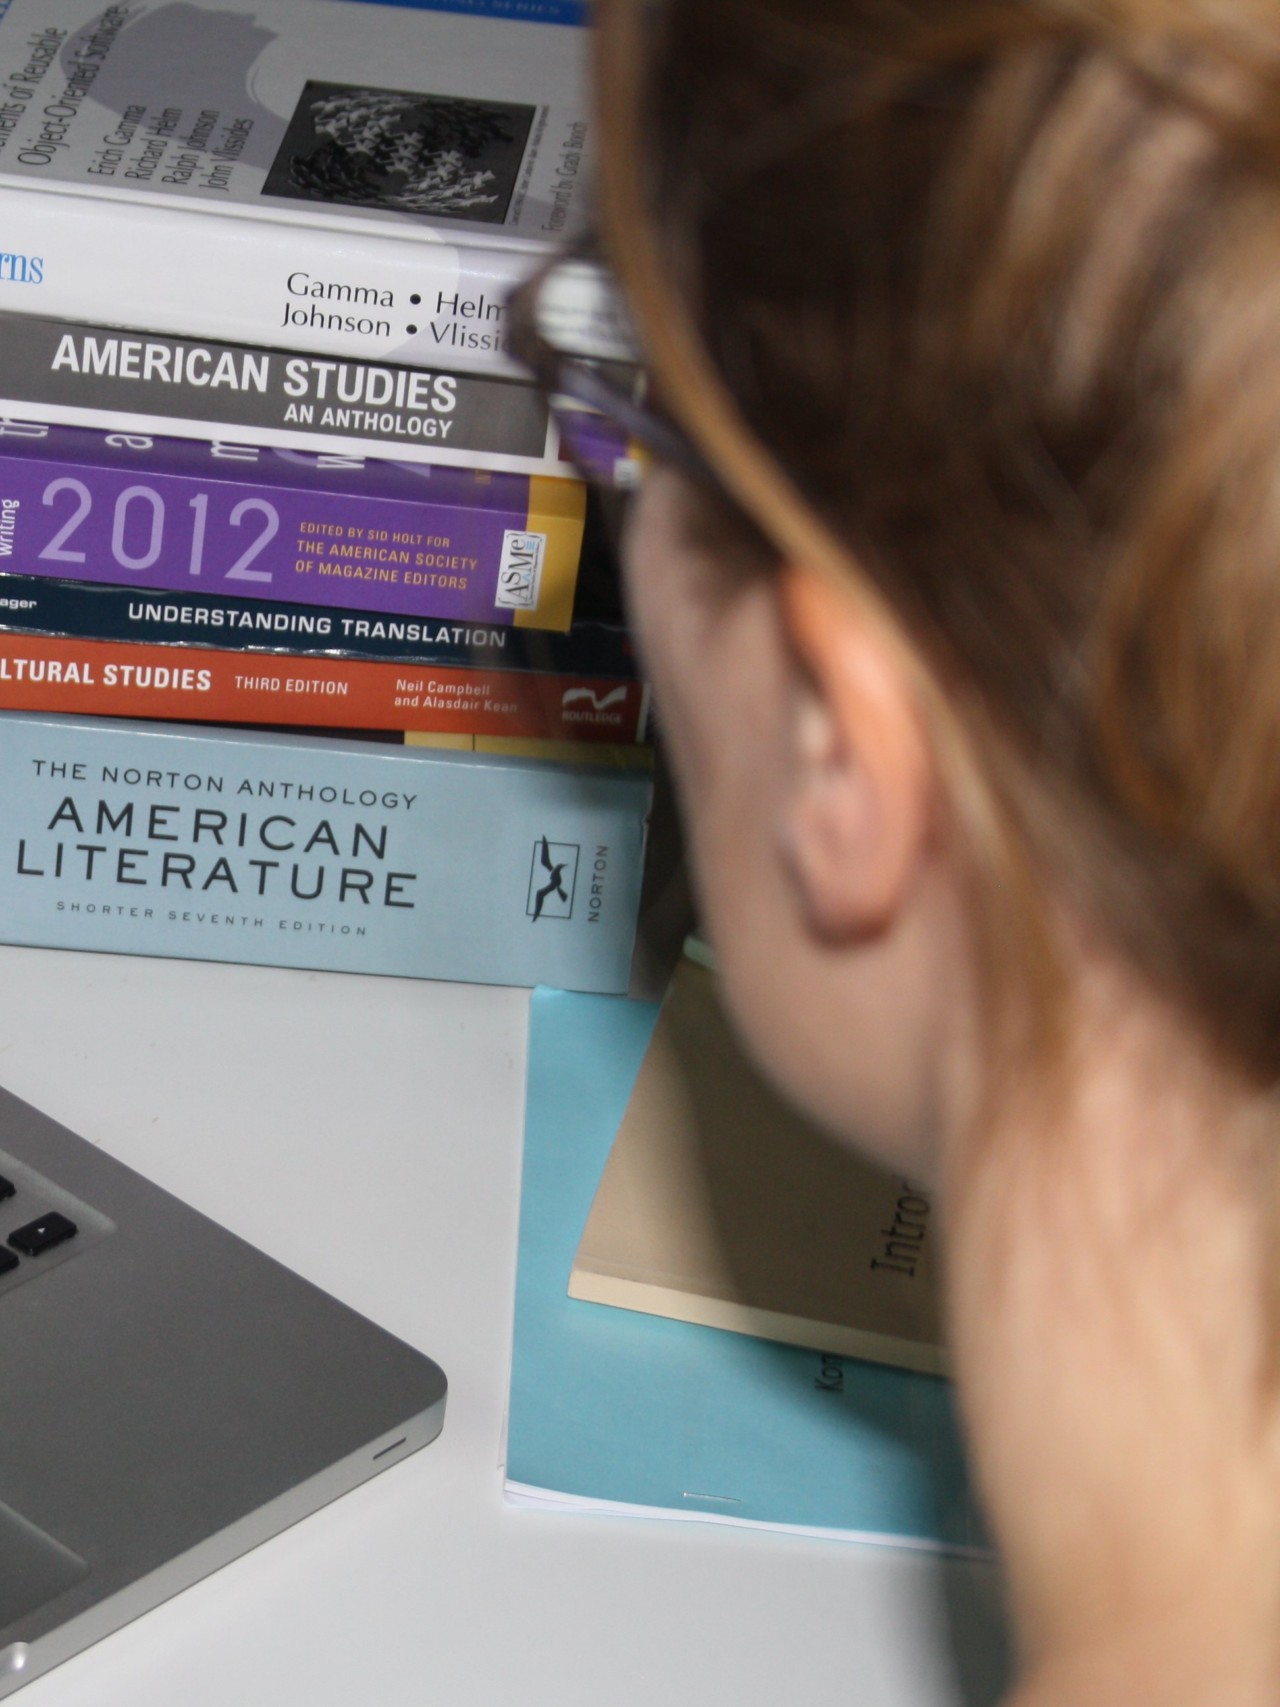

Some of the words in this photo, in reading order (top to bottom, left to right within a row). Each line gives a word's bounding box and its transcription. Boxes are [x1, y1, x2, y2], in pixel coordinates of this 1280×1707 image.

[3, 73, 35, 100] of
[20, 27, 68, 84] Reusable
[17, 60, 101, 166] Object-Oriented
[81, 4, 129, 60] Software
[104, 104, 147, 147] Gamma
[124, 137, 168, 181] Richard
[146, 107, 183, 138] Helm
[177, 109, 220, 154] Johnson
[210, 117, 254, 162] Vlissides
[88, 144, 123, 177] Erich
[161, 153, 205, 186] Ralph
[198, 165, 234, 192] John
[286, 272, 395, 308] Gamma
[436, 291, 508, 322] Helm
[280, 302, 391, 337] Johnson
[430, 321, 506, 352] Vlissi
[51, 334, 269, 393] AMERICAN
[283, 358, 458, 413] STUDIES
[283, 403, 314, 424] AN
[320, 407, 453, 439] ANTHOLOGY
[38, 477, 280, 583] 2012
[300, 521, 343, 537] EDITED
[348, 525, 363, 538] BY
[367, 527, 388, 542] SID
[392, 531, 422, 546] HOLT
[427, 535, 450, 549] FOR
[295, 559, 314, 574] OF
[318, 562, 399, 584] MAGAZINE
[404, 571, 468, 590] EDITORS
[297, 540, 324, 555] THE
[329, 543, 410, 564] AMERICAN
[415, 552, 478, 571] SOCIETY
[128, 603, 332, 635] UNDERSTANDING
[341, 619, 506, 648] TRANSLATION
[103, 664, 212, 692] STUDIES
[234, 675, 282, 692] THIRD
[285, 678, 349, 696] EDITION
[396, 678, 424, 693] Neil
[427, 680, 491, 697] Campbell
[394, 694, 420, 708] and
[423, 696, 481, 711] Alasdair
[32, 760, 88, 781] THE
[102, 766, 224, 794] NORTON
[237, 779, 418, 811] ANTHOLOGY
[47, 796, 389, 860] AMERICAN
[17, 838, 418, 909] LITERATURE
[588, 845, 609, 923] NORTON
[56, 901, 154, 919] SHORTER
[168, 909, 265, 928] SEVENTH
[279, 919, 367, 937] EDITION
[870, 1185, 931, 1277] Intro
